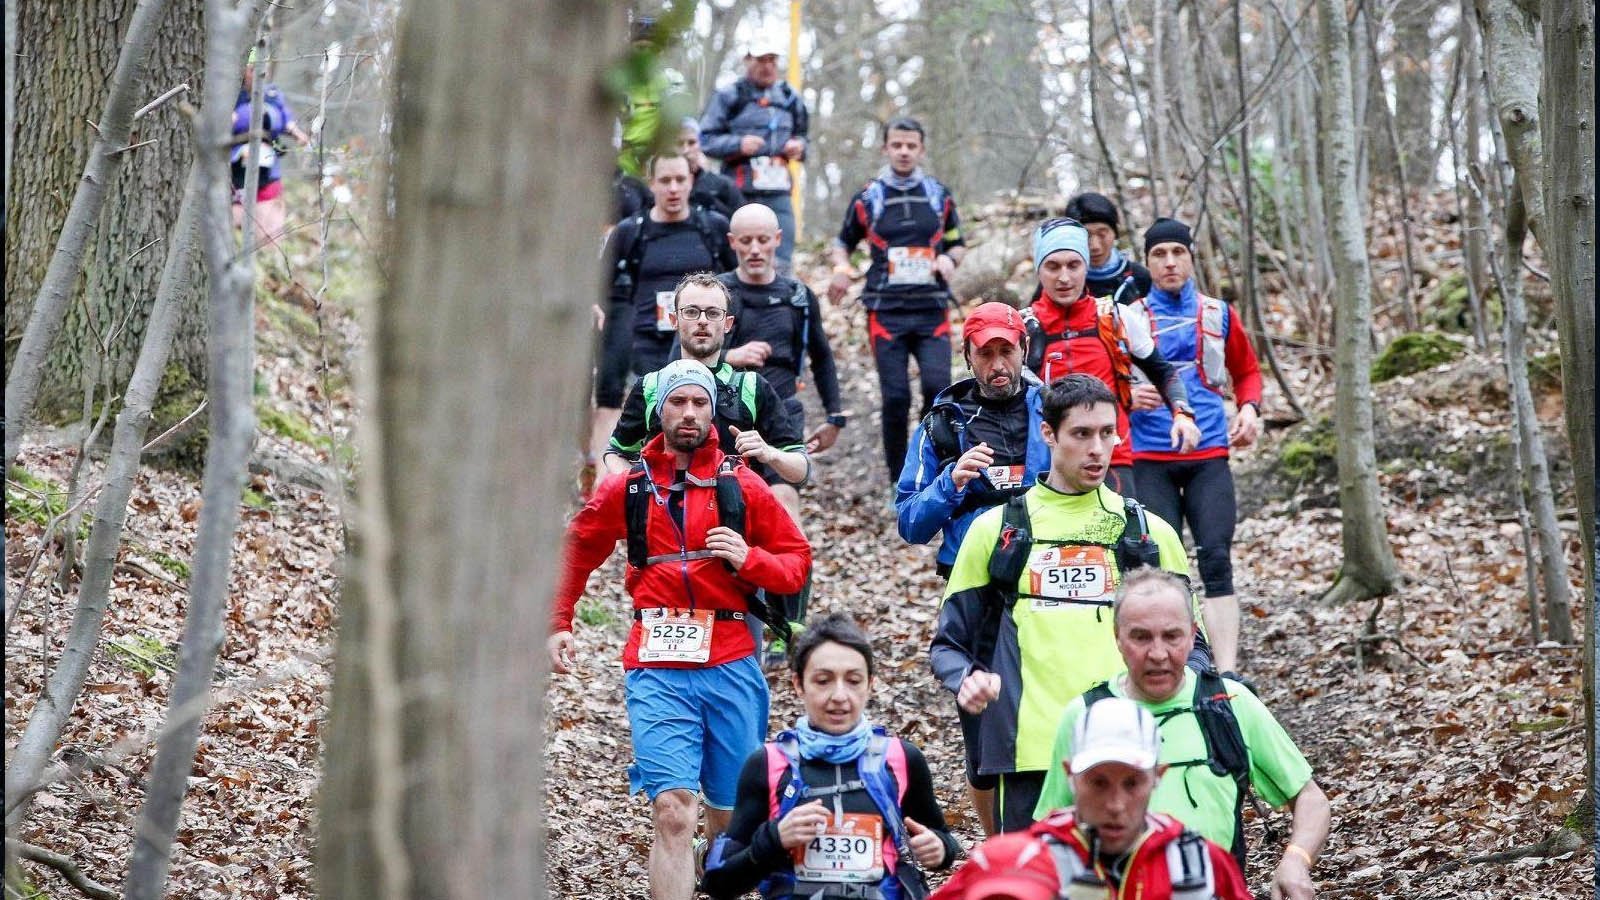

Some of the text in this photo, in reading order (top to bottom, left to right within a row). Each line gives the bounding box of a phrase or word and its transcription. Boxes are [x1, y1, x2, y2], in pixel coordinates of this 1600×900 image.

[1048, 567, 1097, 584] 5125
[652, 625, 698, 640] 5252
[808, 837, 867, 854] 4330
